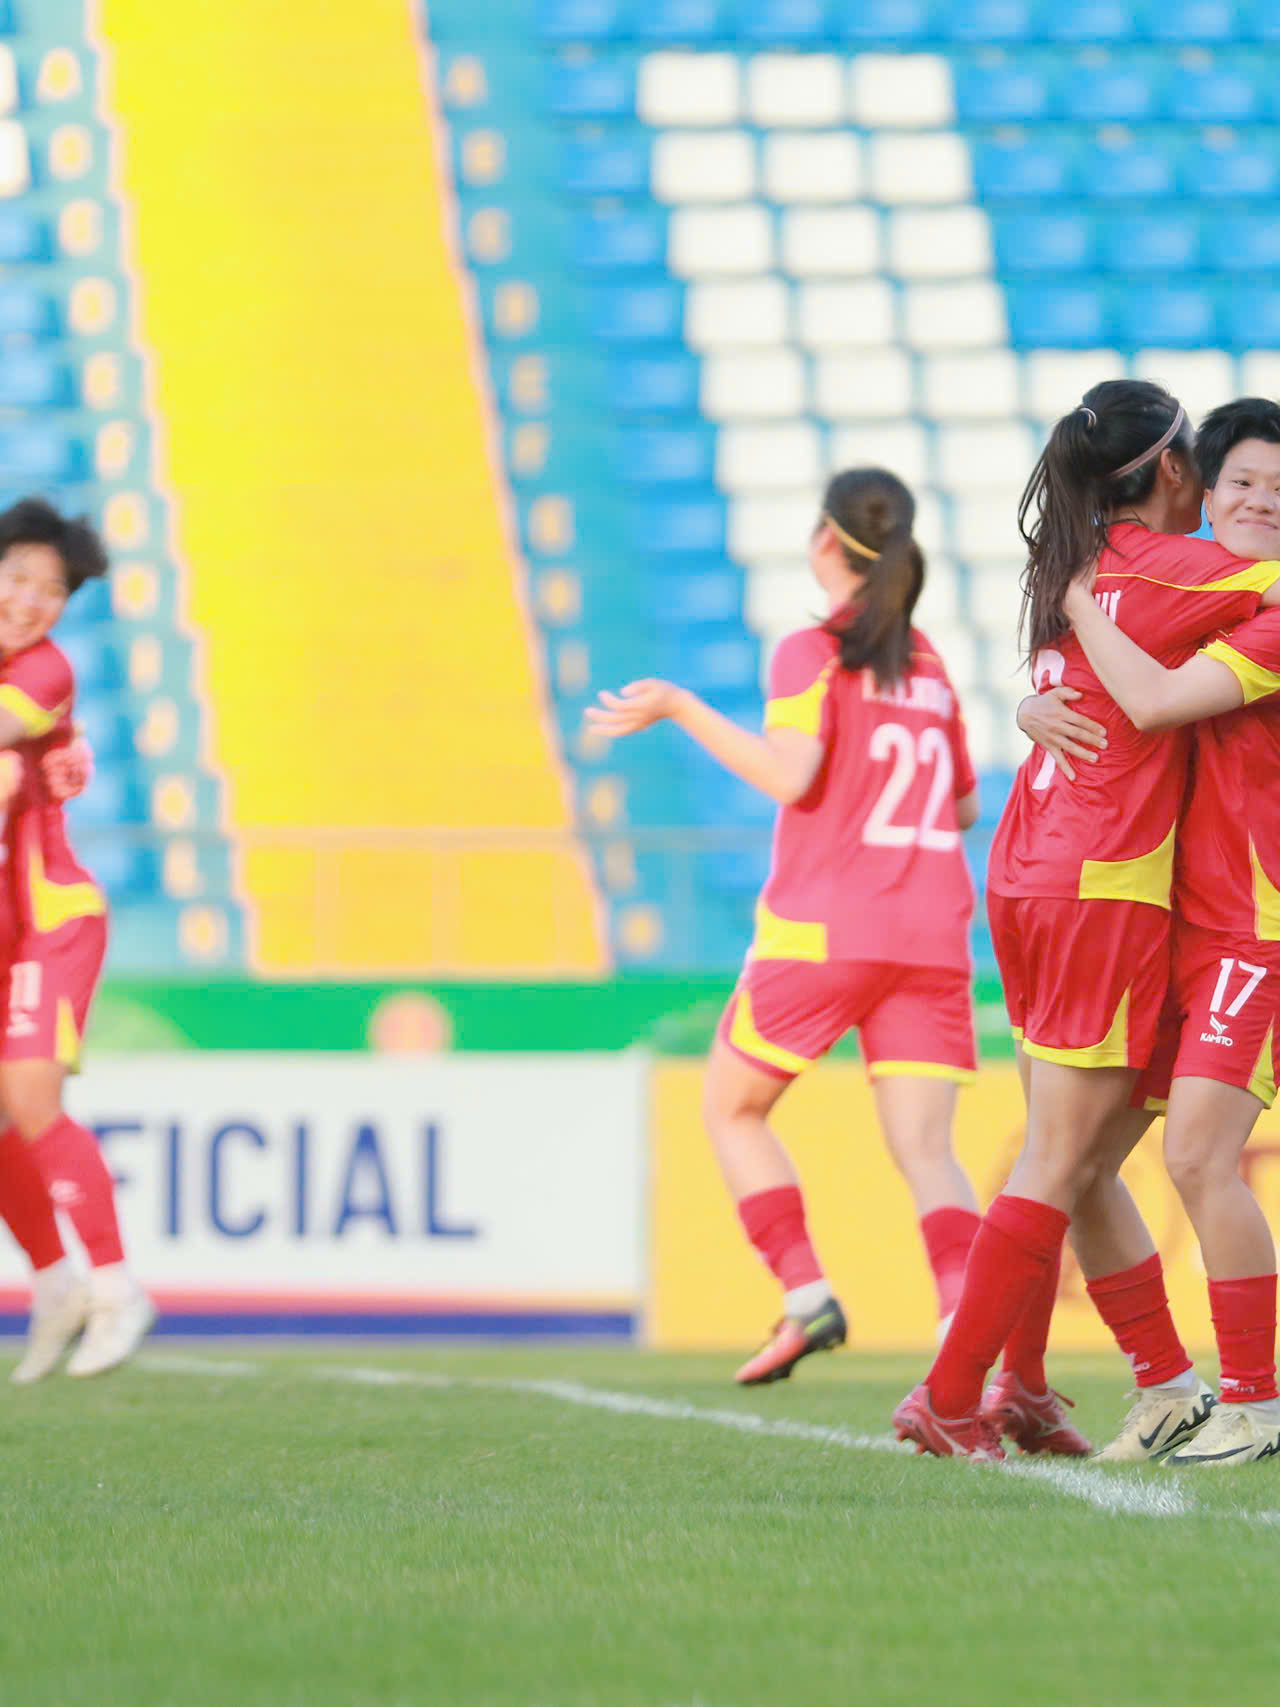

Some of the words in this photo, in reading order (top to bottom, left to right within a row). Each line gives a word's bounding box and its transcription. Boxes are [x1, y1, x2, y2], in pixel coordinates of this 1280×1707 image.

[861, 722, 960, 851] 22
[1209, 957, 1268, 1017] 17
[1199, 1032, 1234, 1047] KAMITO
